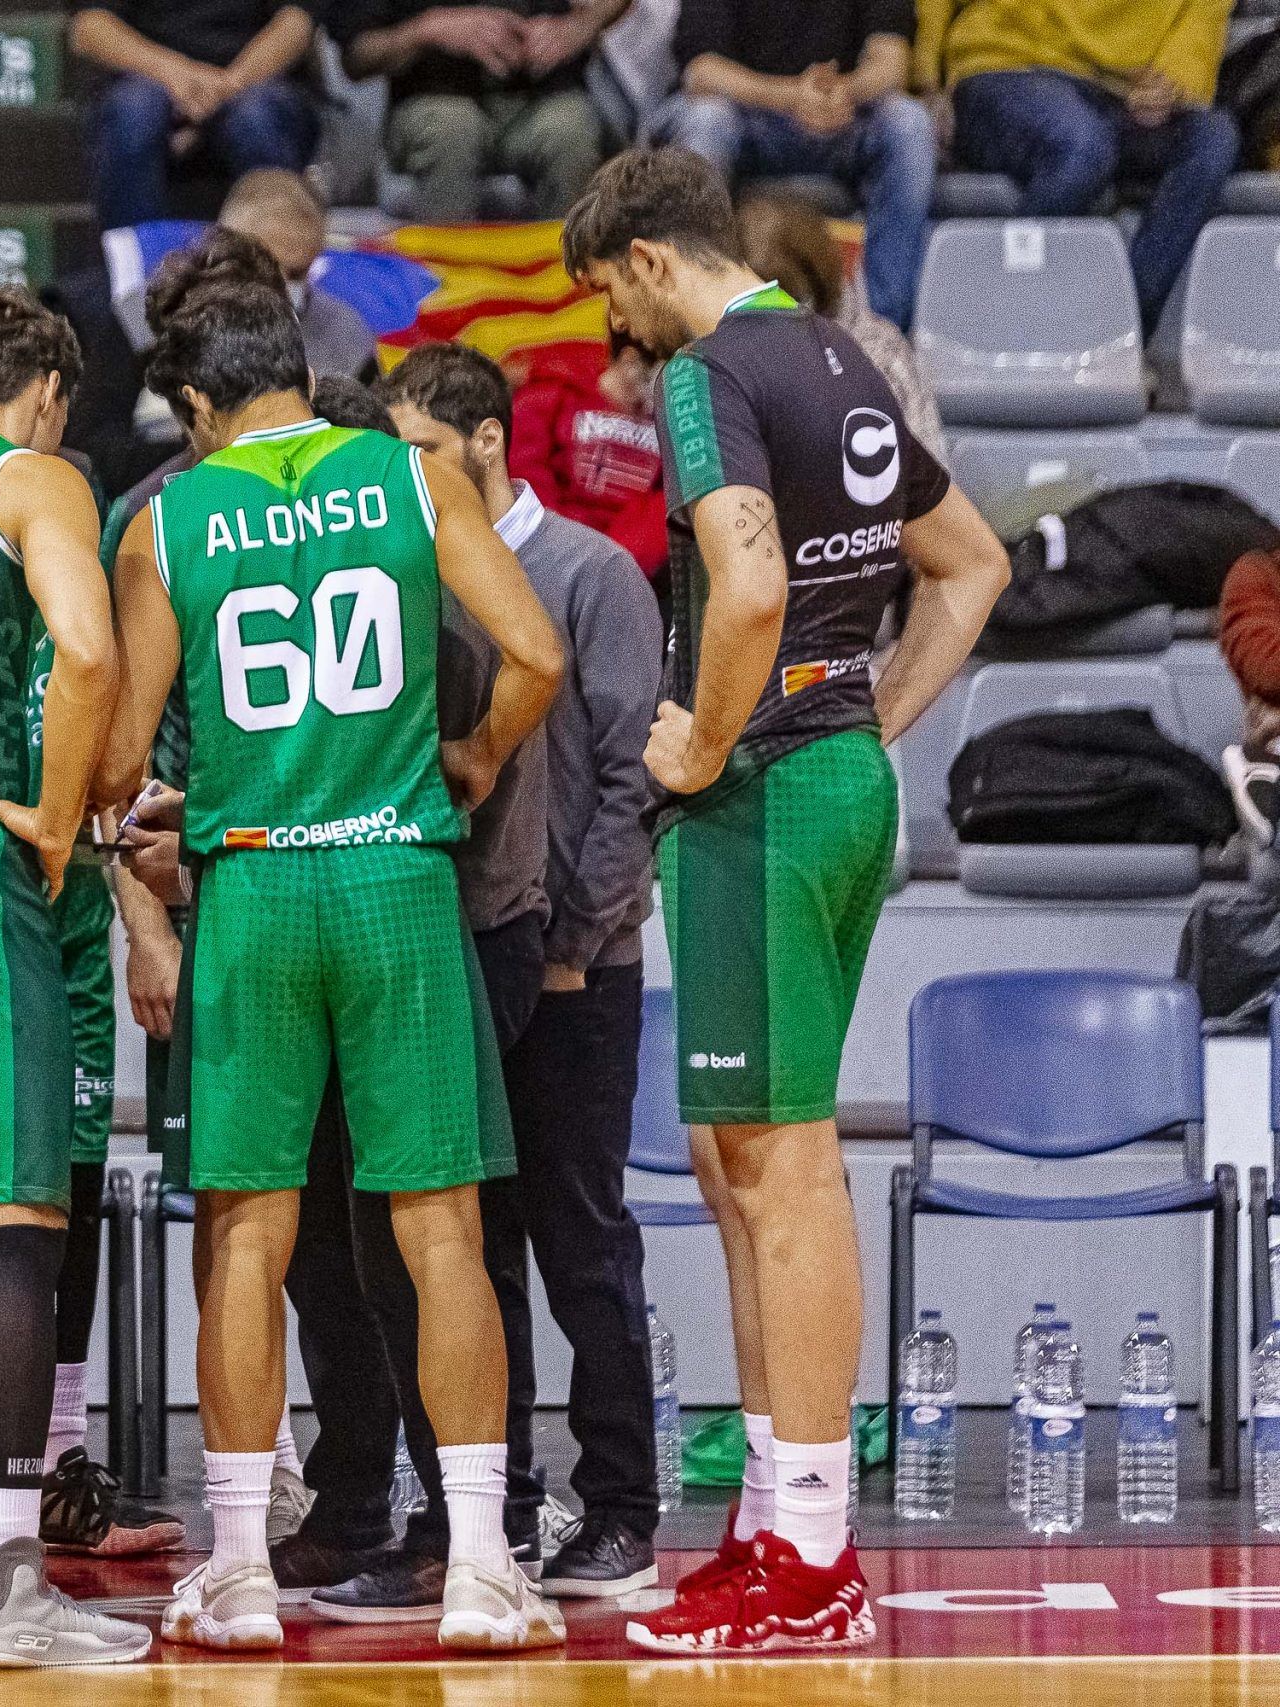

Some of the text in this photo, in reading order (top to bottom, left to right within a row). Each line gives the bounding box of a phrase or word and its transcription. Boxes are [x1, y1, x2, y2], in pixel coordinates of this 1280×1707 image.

[206, 484, 390, 558] ALONSO
[796, 518, 903, 566] COSEHIS
[216, 566, 405, 733] 60
[270, 805, 397, 849] GOBIERNO
[710, 1051, 746, 1069] barri
[163, 1113, 186, 1129] arri
